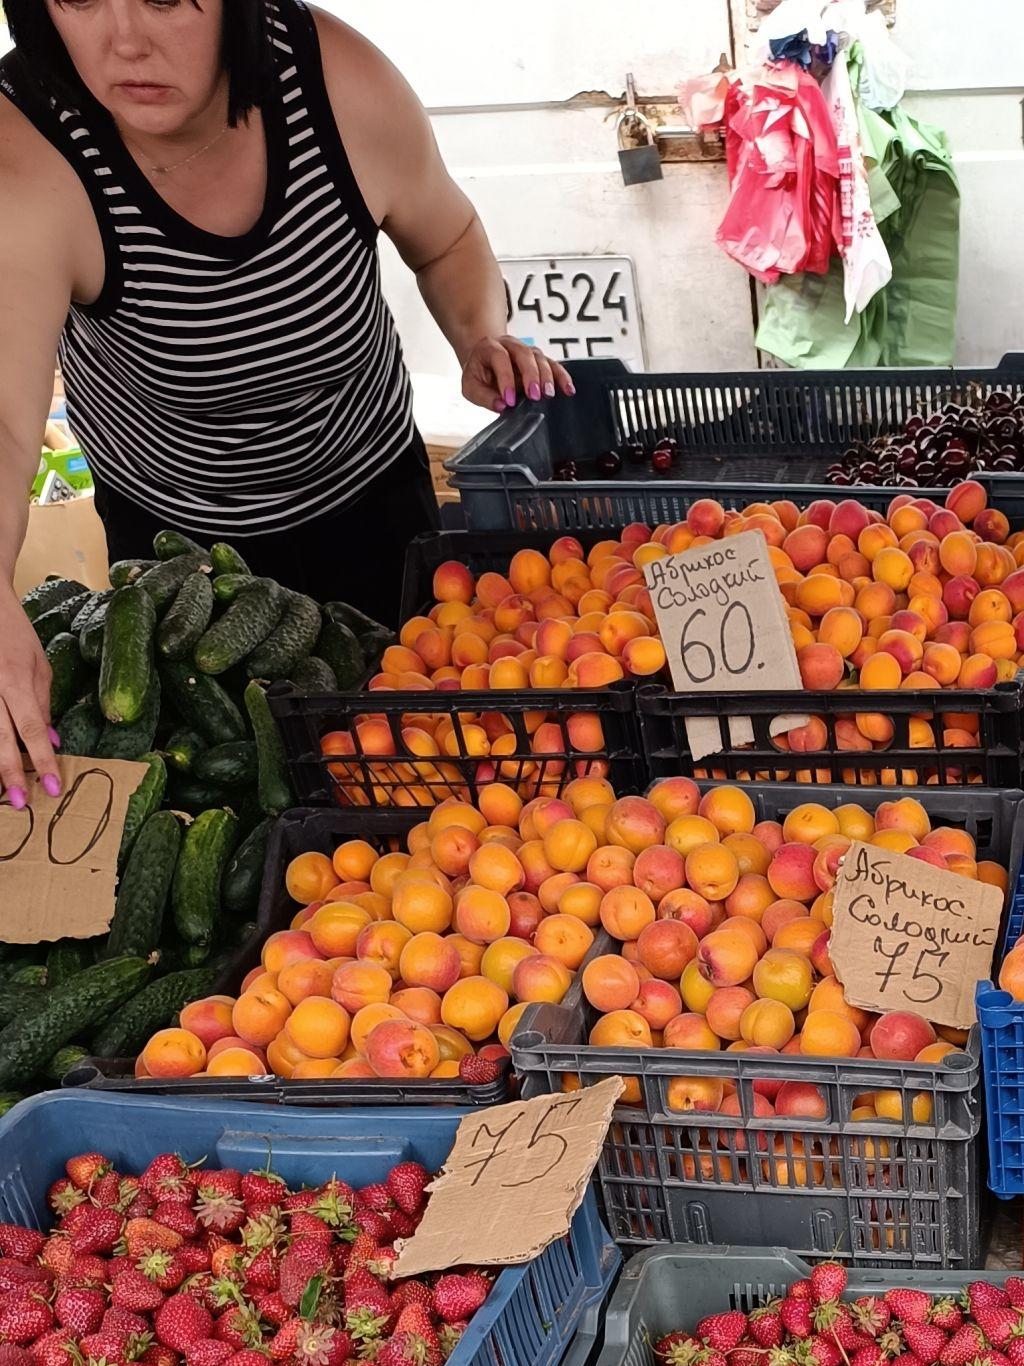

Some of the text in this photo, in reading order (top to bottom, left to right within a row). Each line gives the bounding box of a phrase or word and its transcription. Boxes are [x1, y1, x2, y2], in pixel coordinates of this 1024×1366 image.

[648, 548, 737, 590] Абрикос
[657, 558, 765, 609] Солодкий
[848, 894, 996, 951] Солодкий
[873, 936, 951, 1004] 75
[464, 1097, 583, 1188] 75
